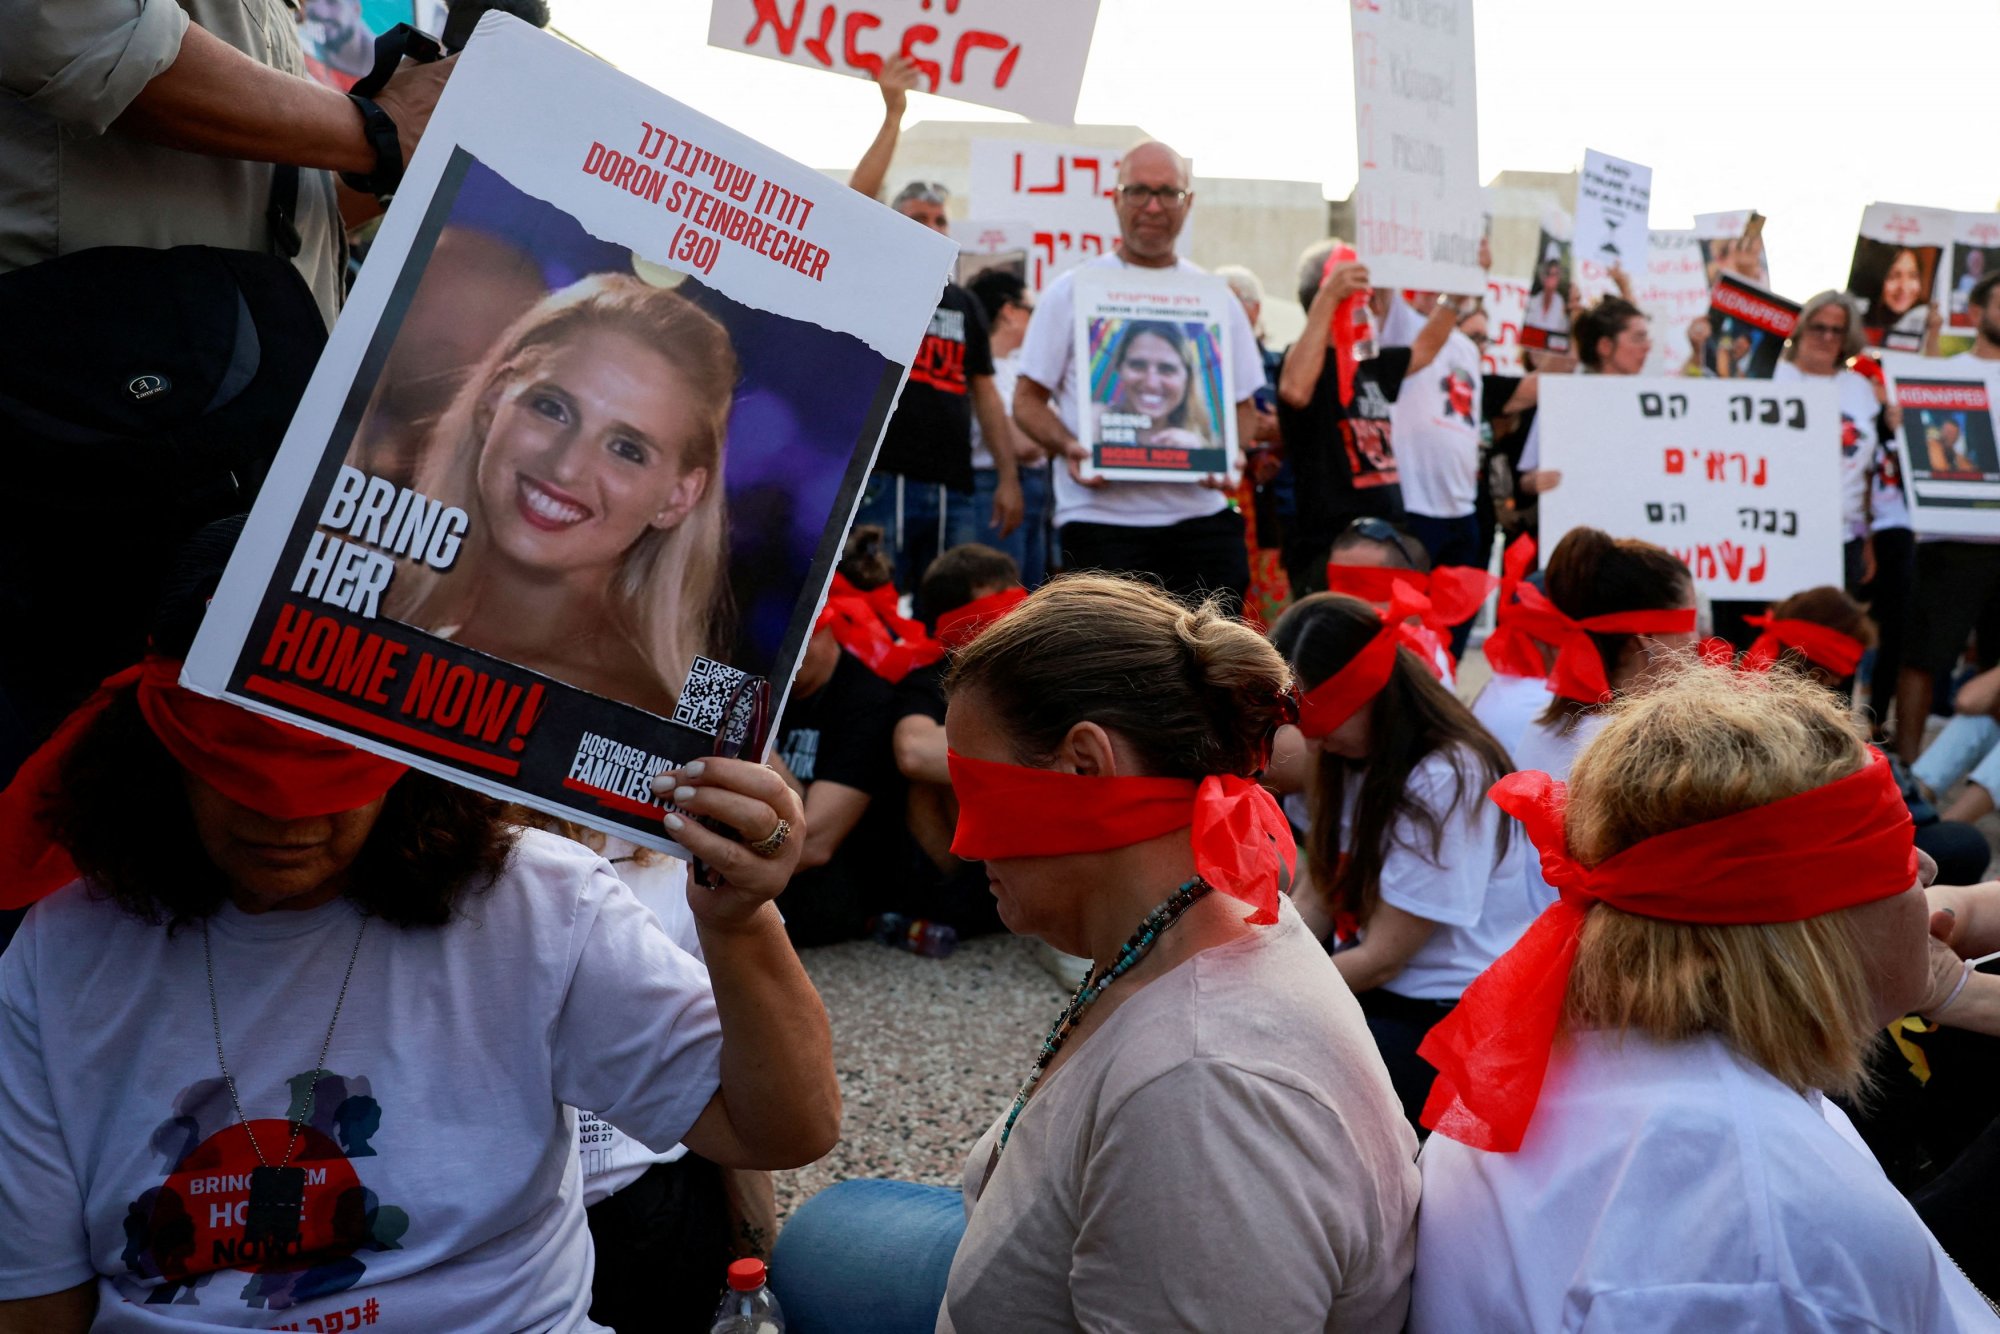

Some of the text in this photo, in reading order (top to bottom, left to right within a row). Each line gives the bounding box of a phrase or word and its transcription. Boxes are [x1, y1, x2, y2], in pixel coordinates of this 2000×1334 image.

[637, 121, 815, 232] דורון שטיינברכר
[581, 141, 831, 283] DORON STEINBRECHER
[667, 223, 722, 276] (30)
[1714, 287, 1795, 332] KIDNAPPED
[135, 386, 164, 399] tamrac
[1640, 392, 1688, 419] הם
[1899, 385, 1986, 407] KIDNAPPED
[1101, 412, 1152, 429] BRING
[1102, 428, 1137, 443] HER
[1101, 447, 1148, 462] HOME
[1664, 448, 1767, 487] נראים
[318, 464, 469, 569] BRING
[1645, 502, 1687, 524] הם
[291, 530, 395, 619] HER
[260, 603, 545, 752] HOME NOW!
[578, 731, 647, 771] HOSTAGES
[568, 751, 654, 804] FAMILIES
[601, 1133, 613, 1142] 27
[209, 1196, 306, 1229] HOE
